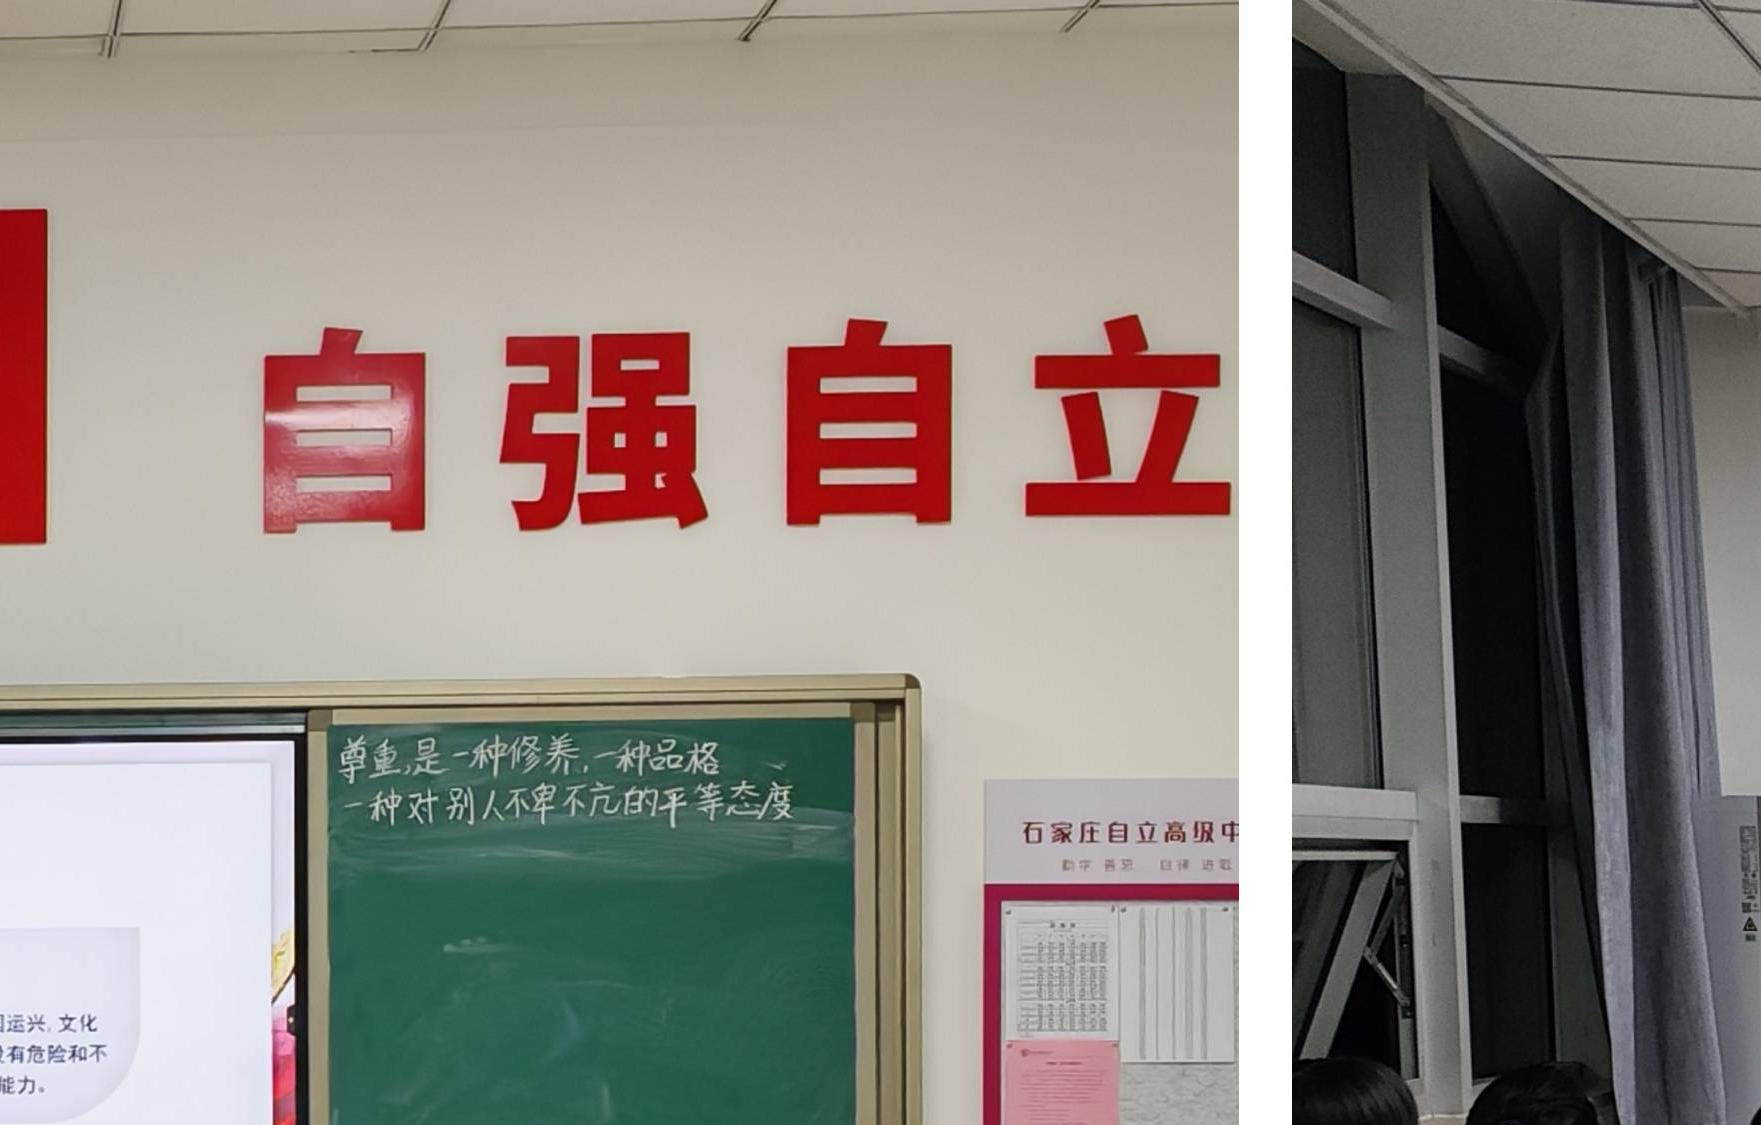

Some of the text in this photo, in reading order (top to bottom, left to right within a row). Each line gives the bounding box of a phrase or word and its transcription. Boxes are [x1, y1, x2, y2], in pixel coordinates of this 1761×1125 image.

[263, 315, 1230, 532] 自强自立
[343, 781, 794, 829] 一种对别人不卑不亢的平等态度
[1023, 820, 1239, 845] 石家庄自立高级中
